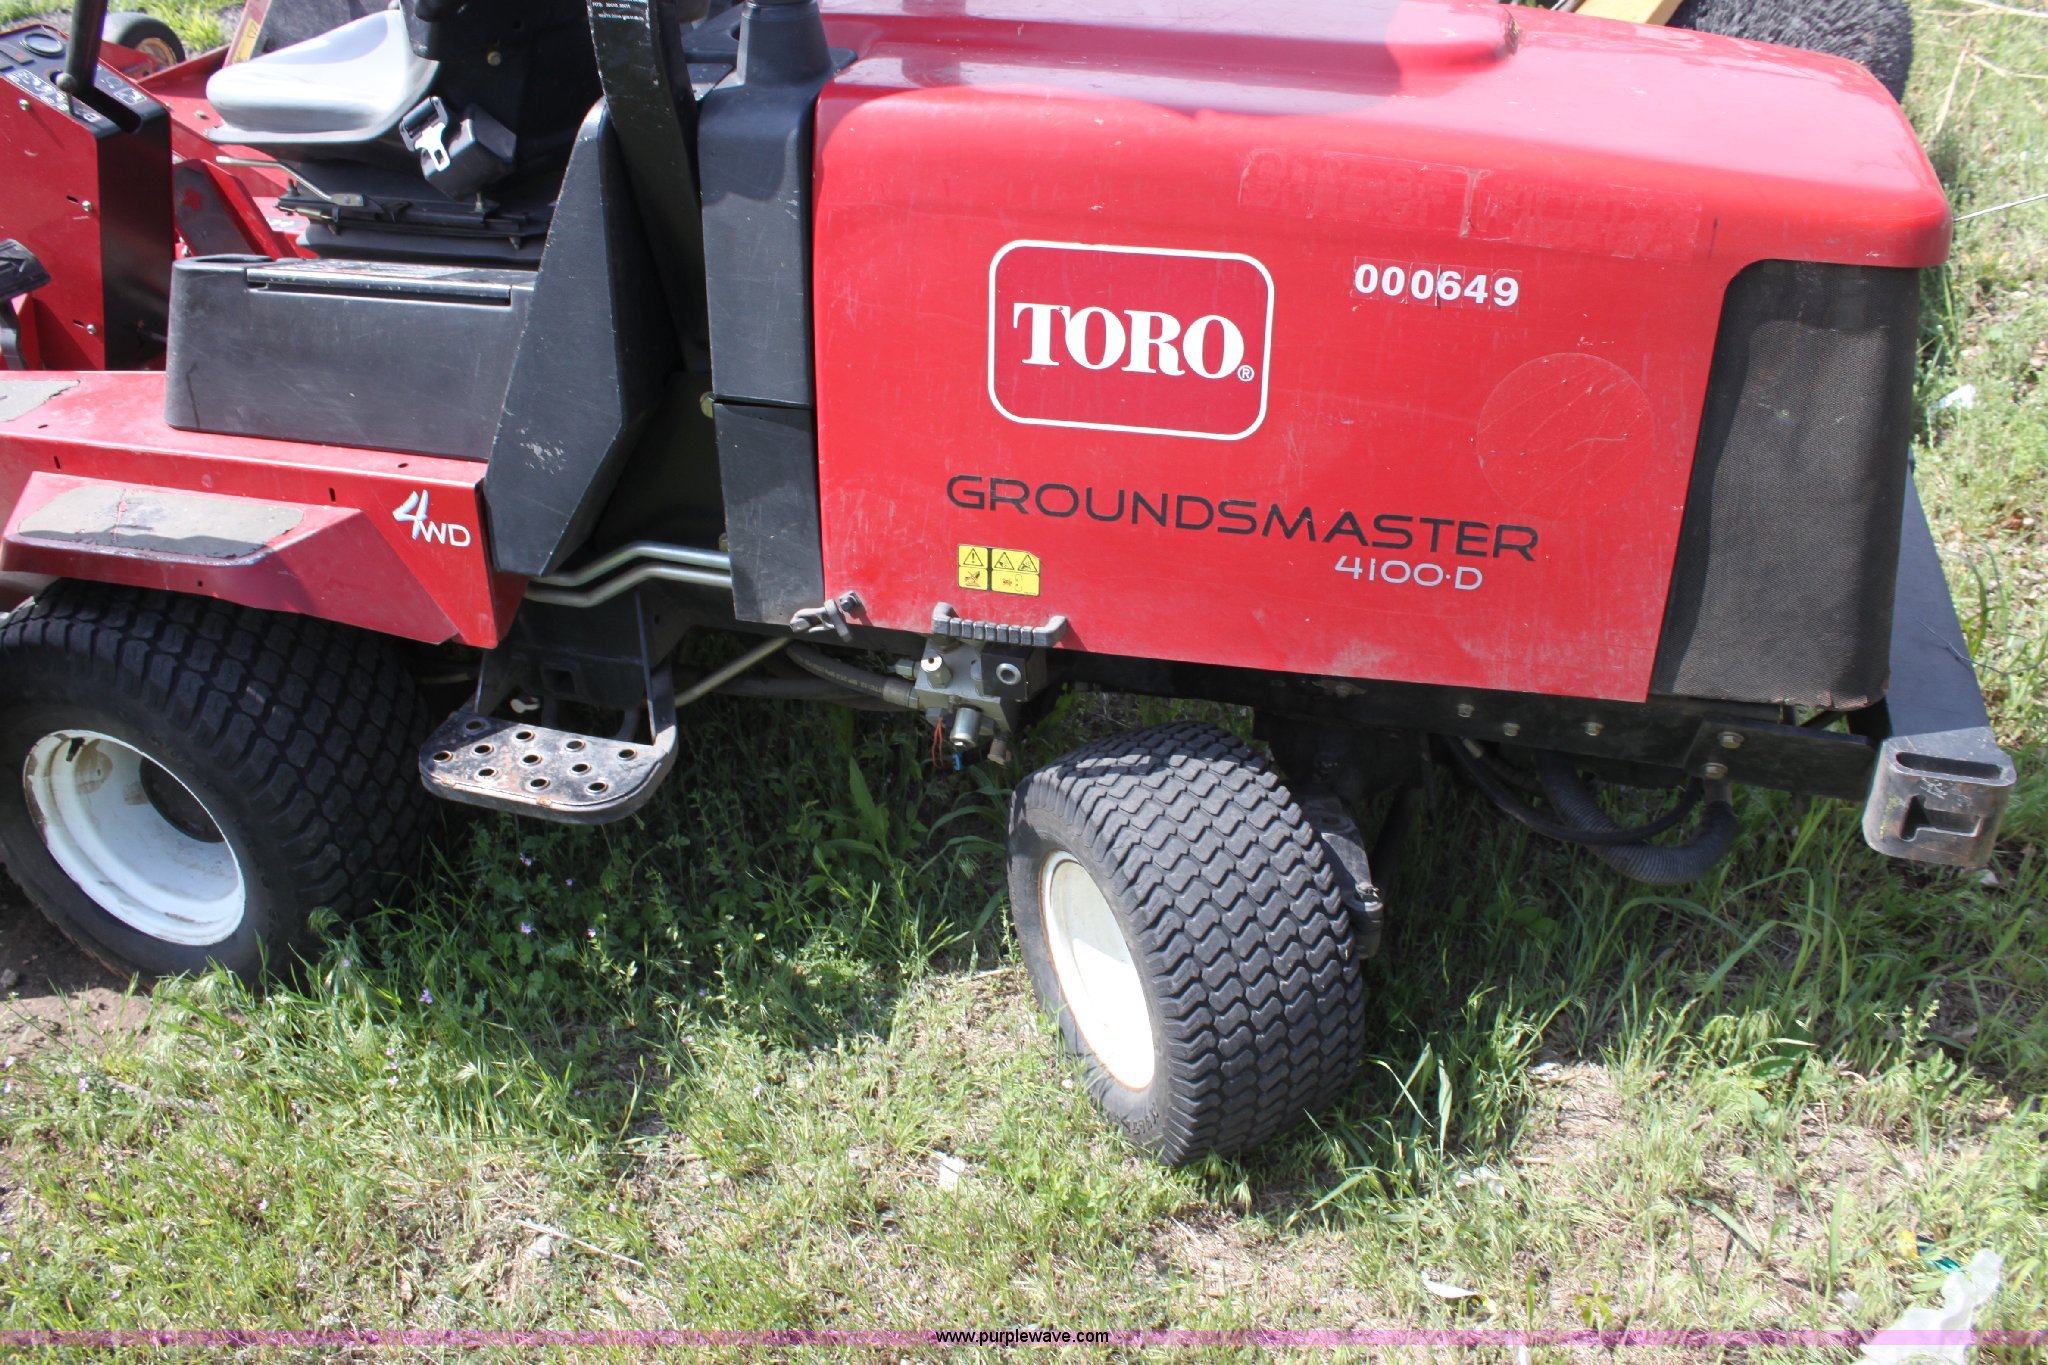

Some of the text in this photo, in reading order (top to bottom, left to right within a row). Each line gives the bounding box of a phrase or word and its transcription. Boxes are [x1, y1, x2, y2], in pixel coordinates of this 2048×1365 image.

[1354, 263, 1519, 307] 000649
[392, 489, 472, 547] 4WD
[947, 474, 1539, 561] GROUNDSMASTER
